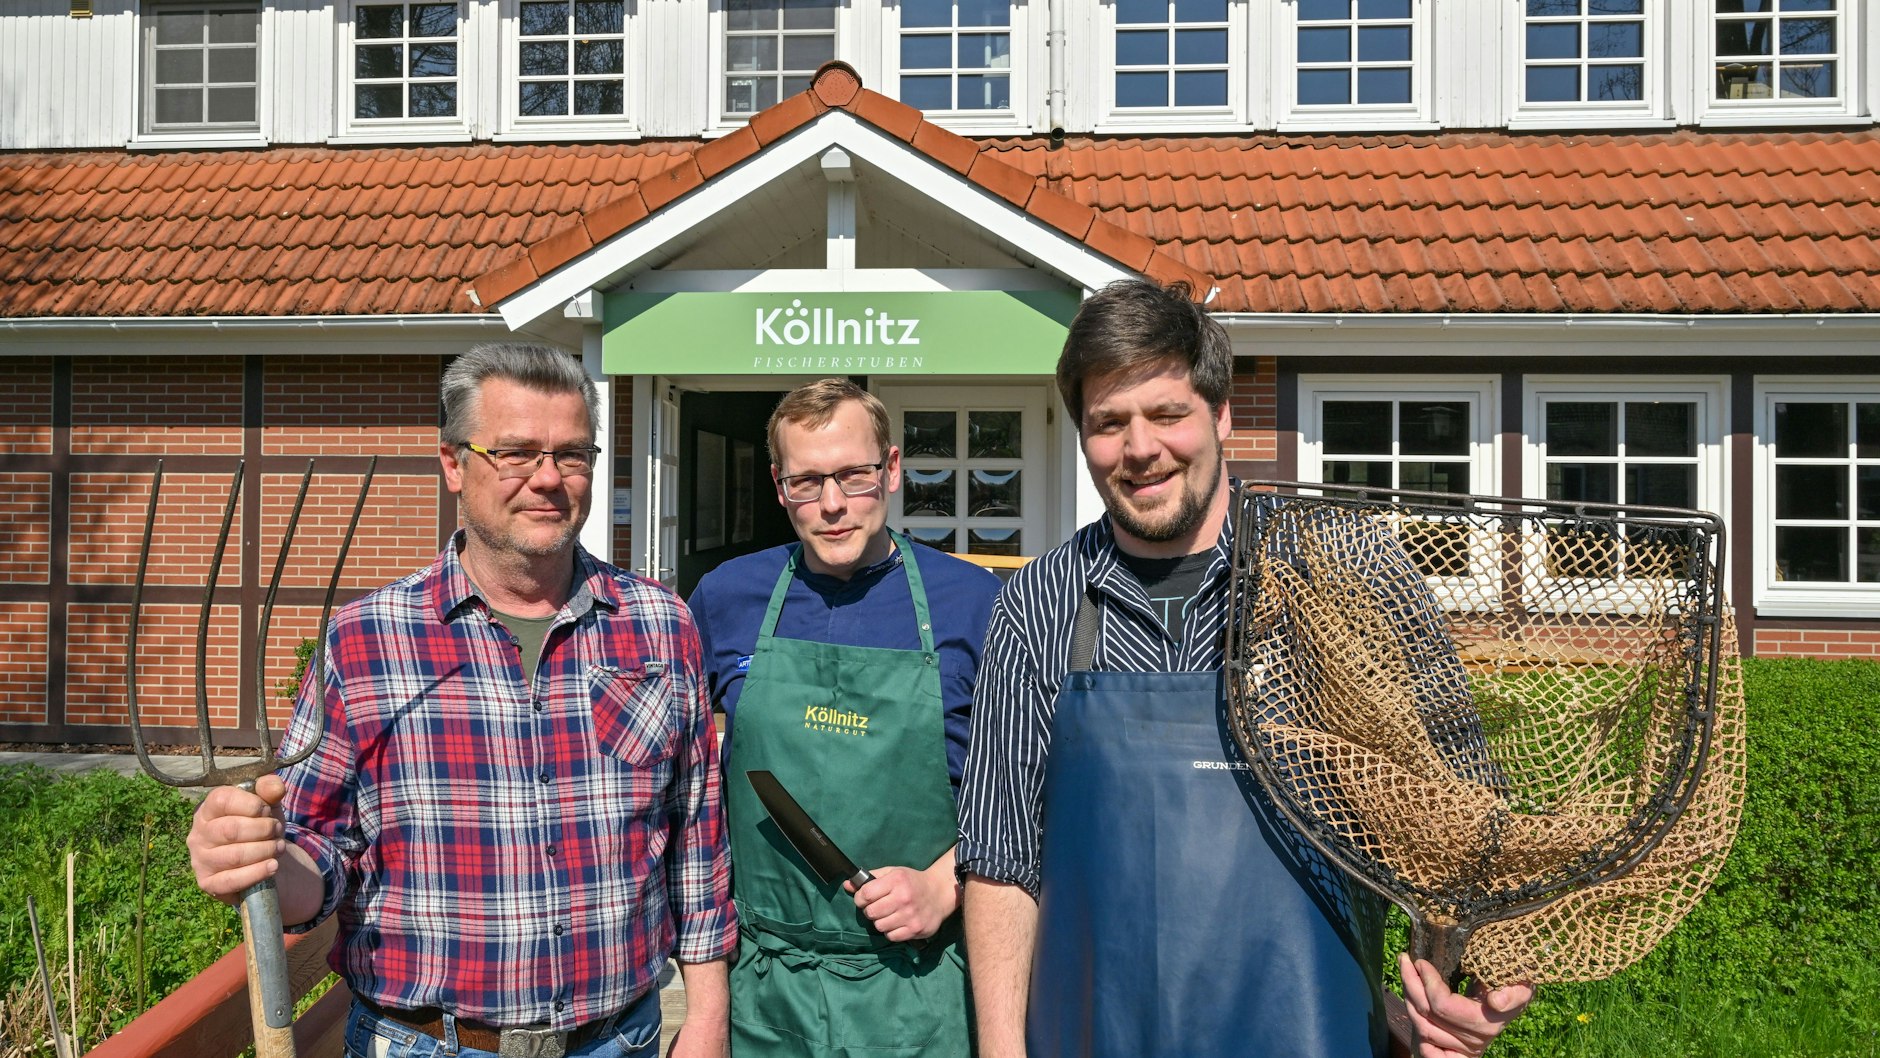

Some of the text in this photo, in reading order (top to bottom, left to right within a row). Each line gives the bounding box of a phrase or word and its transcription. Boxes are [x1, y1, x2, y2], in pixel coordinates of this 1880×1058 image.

[755, 298, 921, 346] Köllnitz
[753, 356, 924, 369] FISCHERSTUBEN
[804, 705, 869, 729] Köllnitz
[804, 722, 866, 737] NATURGUT
